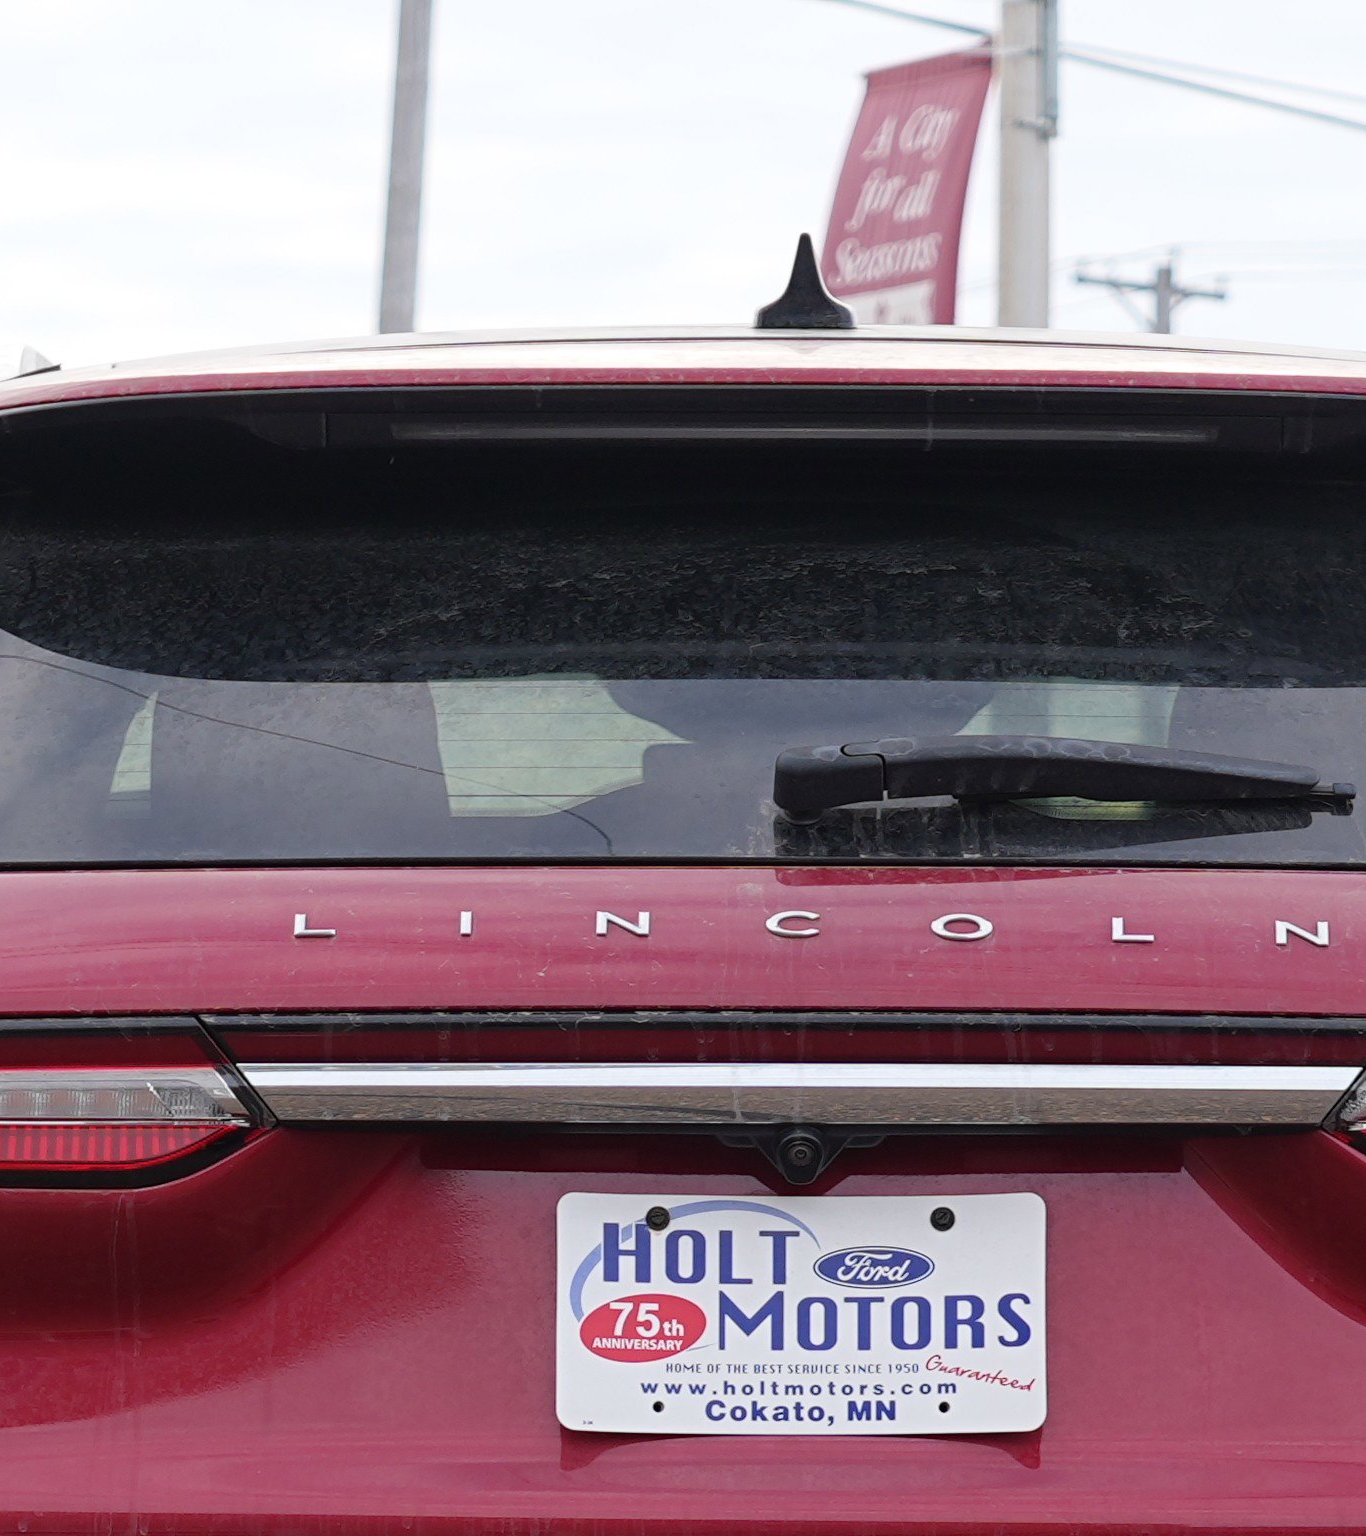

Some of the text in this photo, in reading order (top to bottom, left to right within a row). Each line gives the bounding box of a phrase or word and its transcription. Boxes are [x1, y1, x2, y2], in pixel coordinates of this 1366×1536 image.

[827, 231, 943, 290] Seasons
[294, 910, 1330, 946] LINCOLN
[603, 1222, 800, 1285] HOLT
[837, 1251, 912, 1281] Ford
[609, 1302, 684, 1337] 75th
[719, 1290, 1031, 1351] MOTORS
[592, 1337, 684, 1351] ANNIVERSARY
[666, 1363, 919, 1374] HOME OF THE BEST SERVICE SINCE 1950
[926, 1355, 1035, 1392] Guaranteed
[641, 1380, 957, 1396] www.holtmotors.com
[705, 1400, 896, 1426] Cokato, MN
